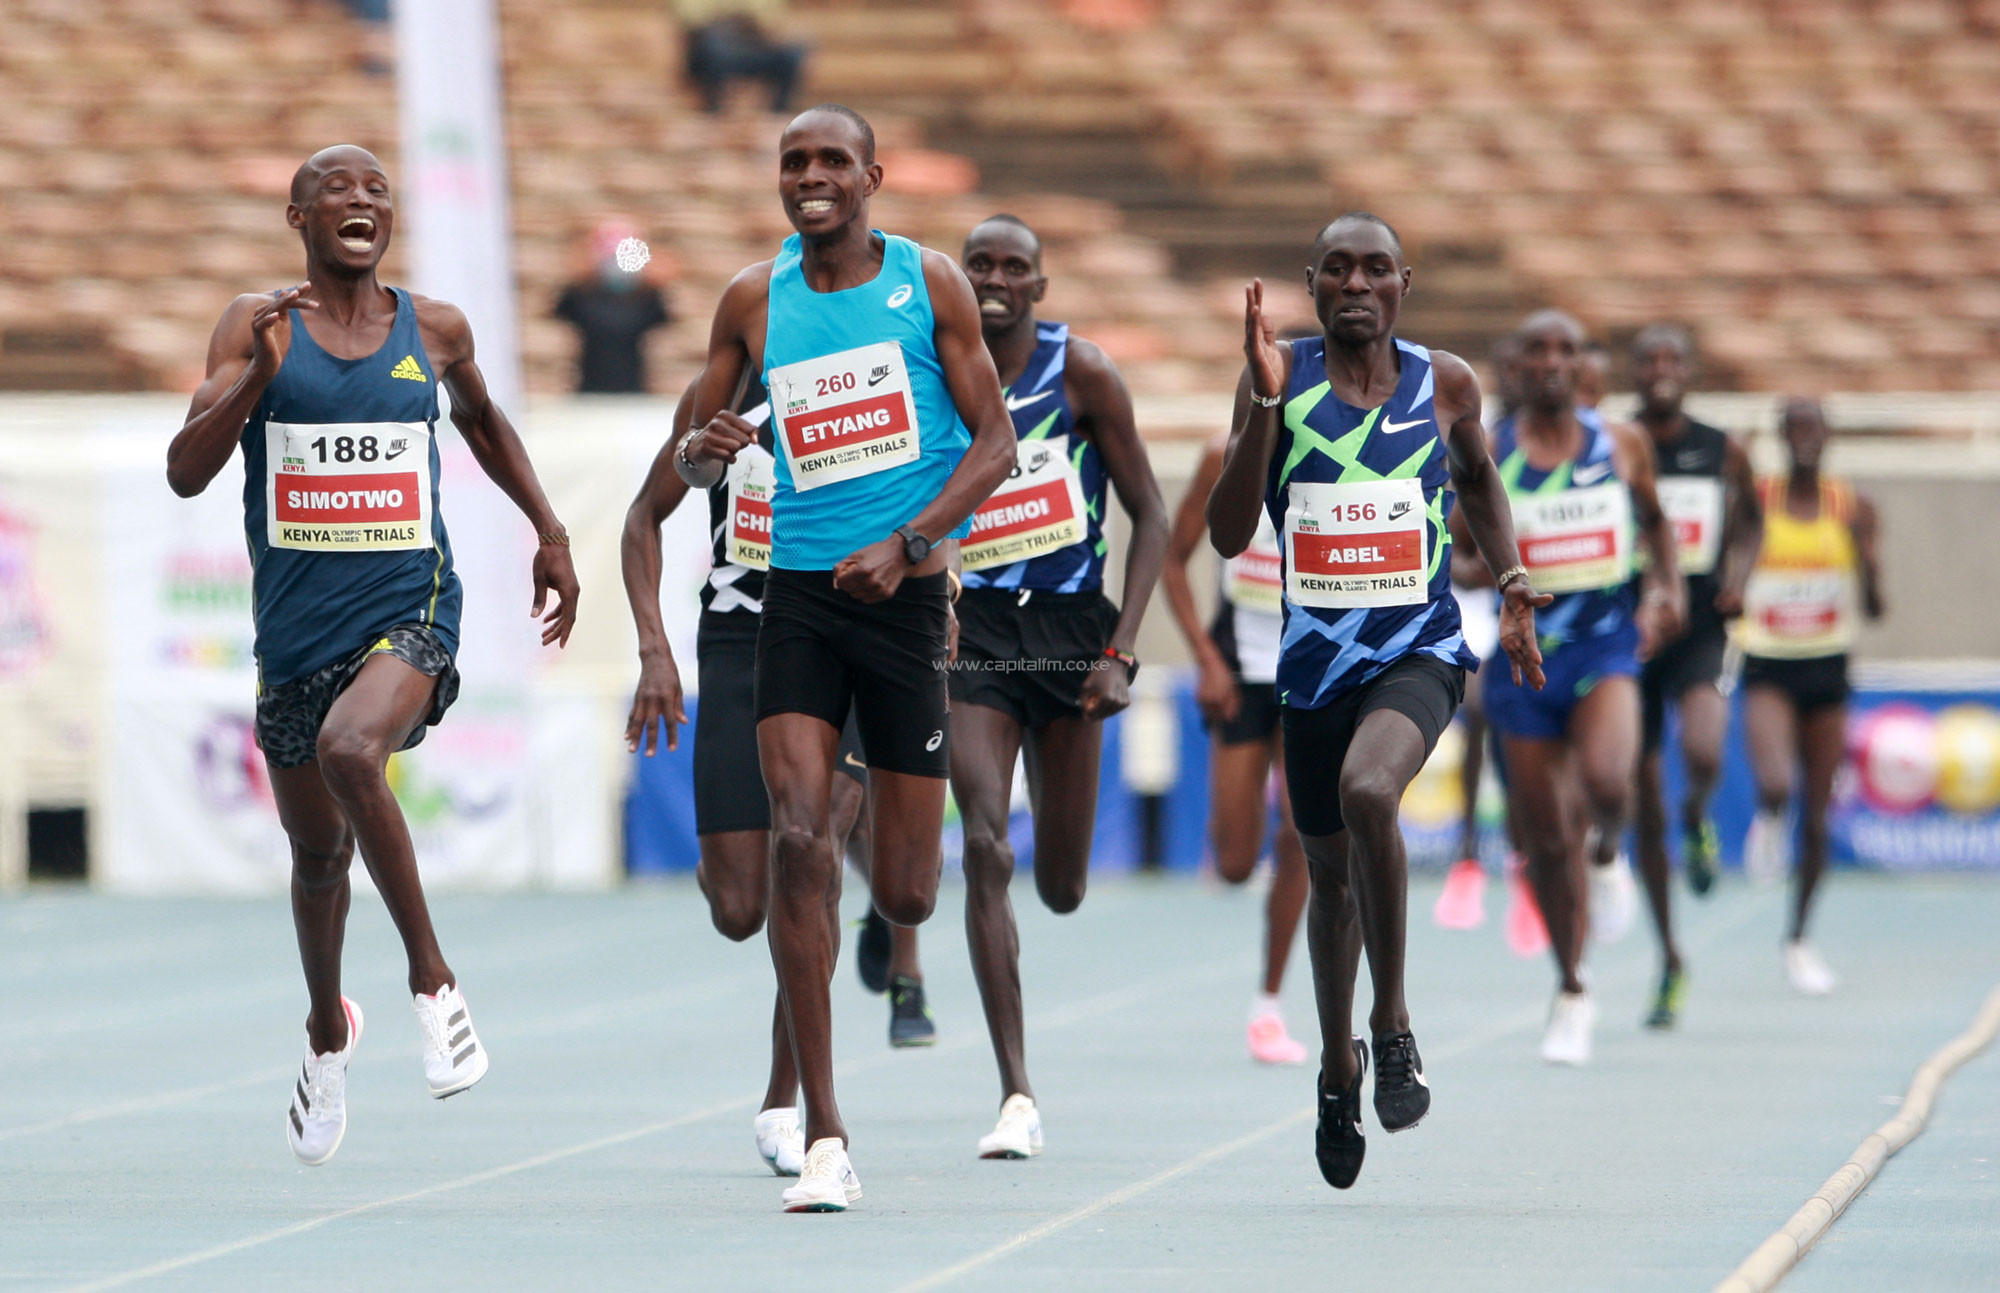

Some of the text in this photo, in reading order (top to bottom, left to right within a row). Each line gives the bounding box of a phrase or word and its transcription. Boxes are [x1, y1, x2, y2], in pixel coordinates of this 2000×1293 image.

[391, 370, 427, 383] adidas
[871, 364, 890, 378] NIKE
[815, 372, 856, 397] 260
[788, 404, 810, 415] KENYA
[801, 408, 892, 444] ETYANG
[311, 435, 379, 463] 188
[390, 438, 408, 450] NIKE
[800, 438, 908, 474] KENYA OLYMPIC GAMES TRIALS
[283, 464, 306, 473] KENYA
[287, 489, 403, 510] SIMOTWO
[743, 490, 767, 499] KENYA
[1331, 503, 1377, 522] 156
[1392, 501, 1411, 512] NIKE
[283, 528, 332, 543] KENYA
[331, 529, 362, 537] OLYMPIC
[363, 527, 415, 542] TRIALS
[1298, 525, 1320, 533] KENYA
[962, 546, 1000, 564] KENYA
[1025, 526, 1072, 548] TRIALS
[1327, 546, 1385, 563] ABEL
[1300, 578, 1343, 592] KENYA
[1371, 576, 1417, 590] TRIALS
